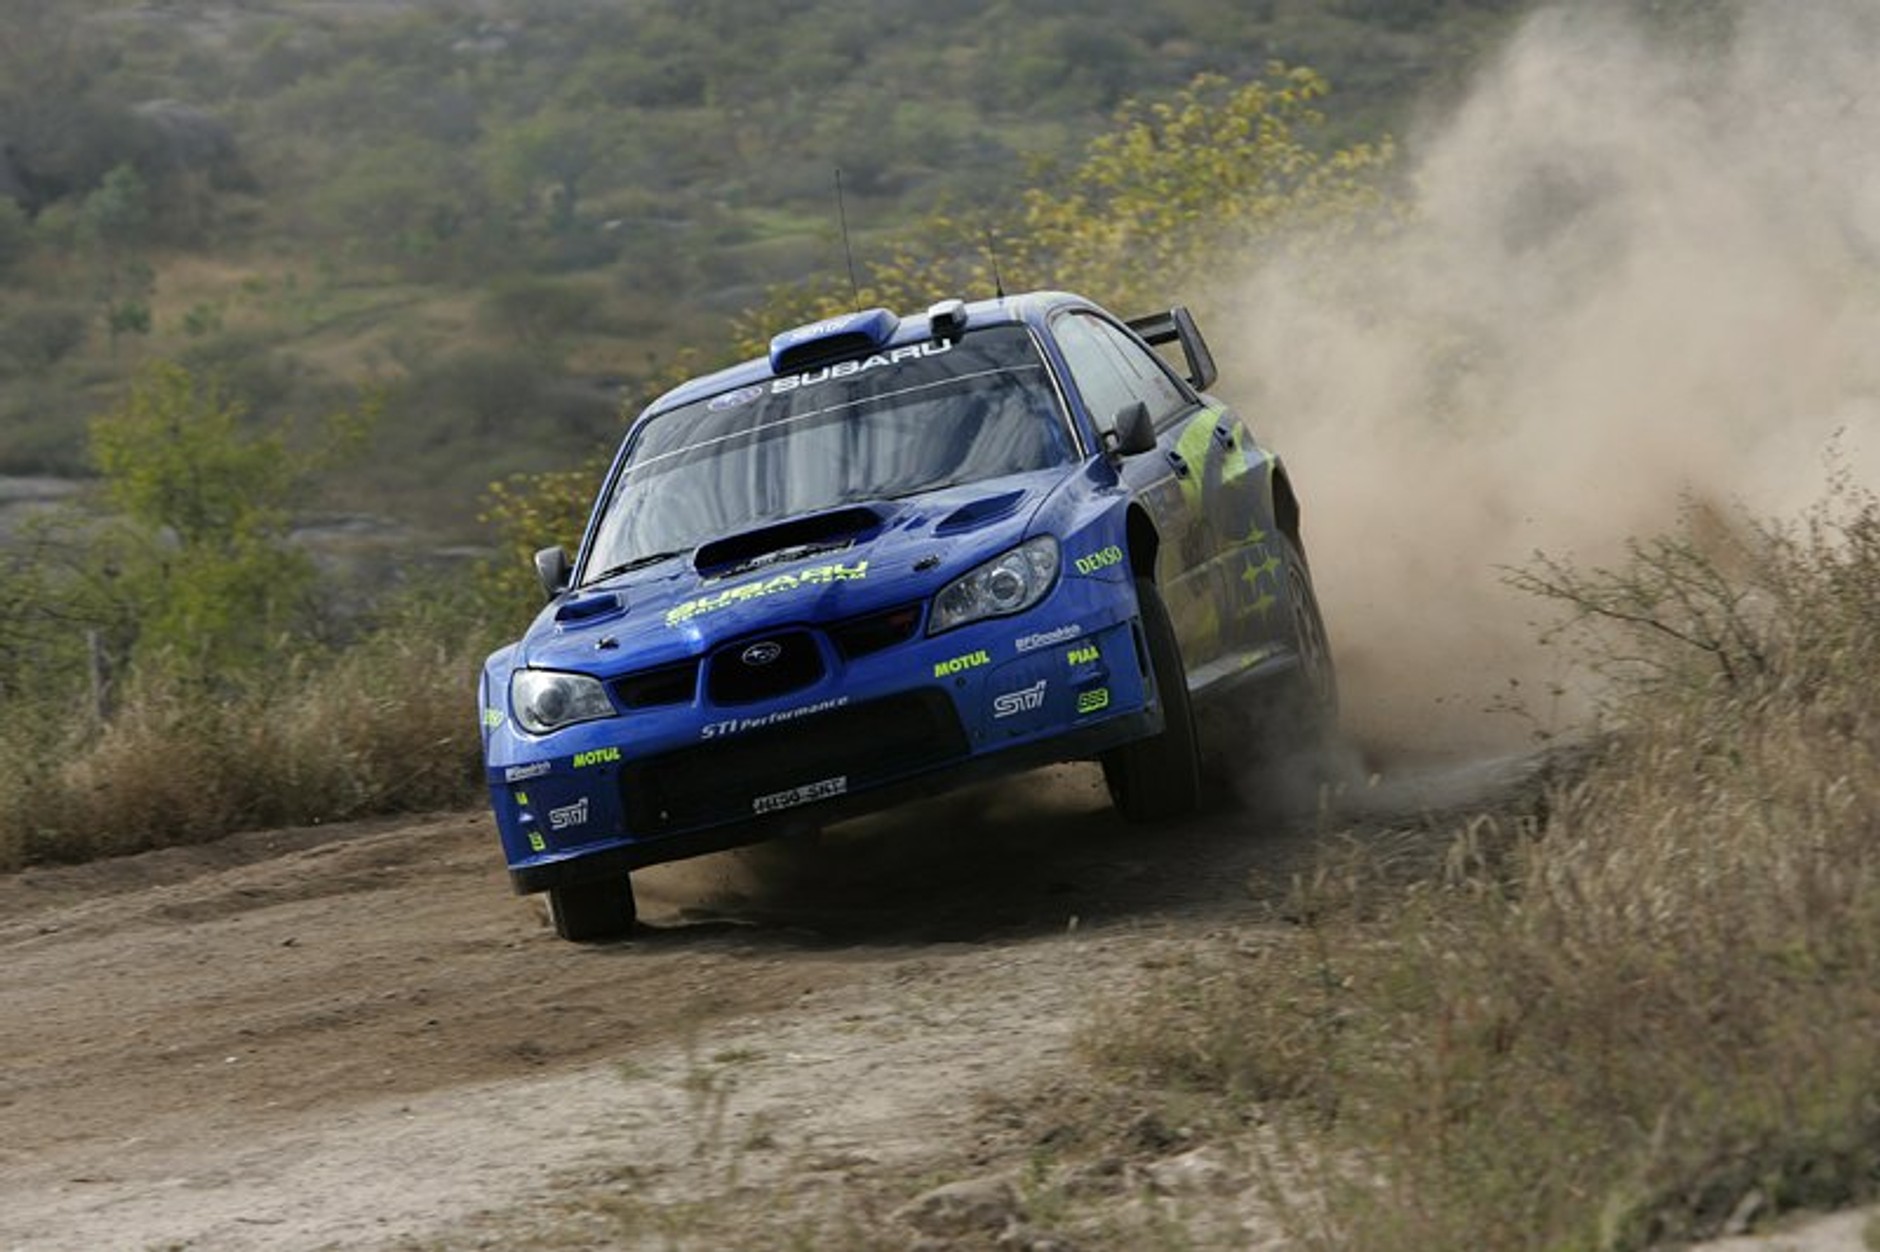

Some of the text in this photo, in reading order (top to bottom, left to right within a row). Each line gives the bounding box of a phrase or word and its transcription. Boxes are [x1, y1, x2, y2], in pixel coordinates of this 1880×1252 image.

[771, 338, 953, 394] SUBARU
[1075, 545, 1122, 575] DENSO
[934, 650, 990, 678] MOTUL
[1067, 647, 1099, 666] PIAA
[701, 697, 848, 739] STI Performance
[573, 747, 622, 768] MOTUL
